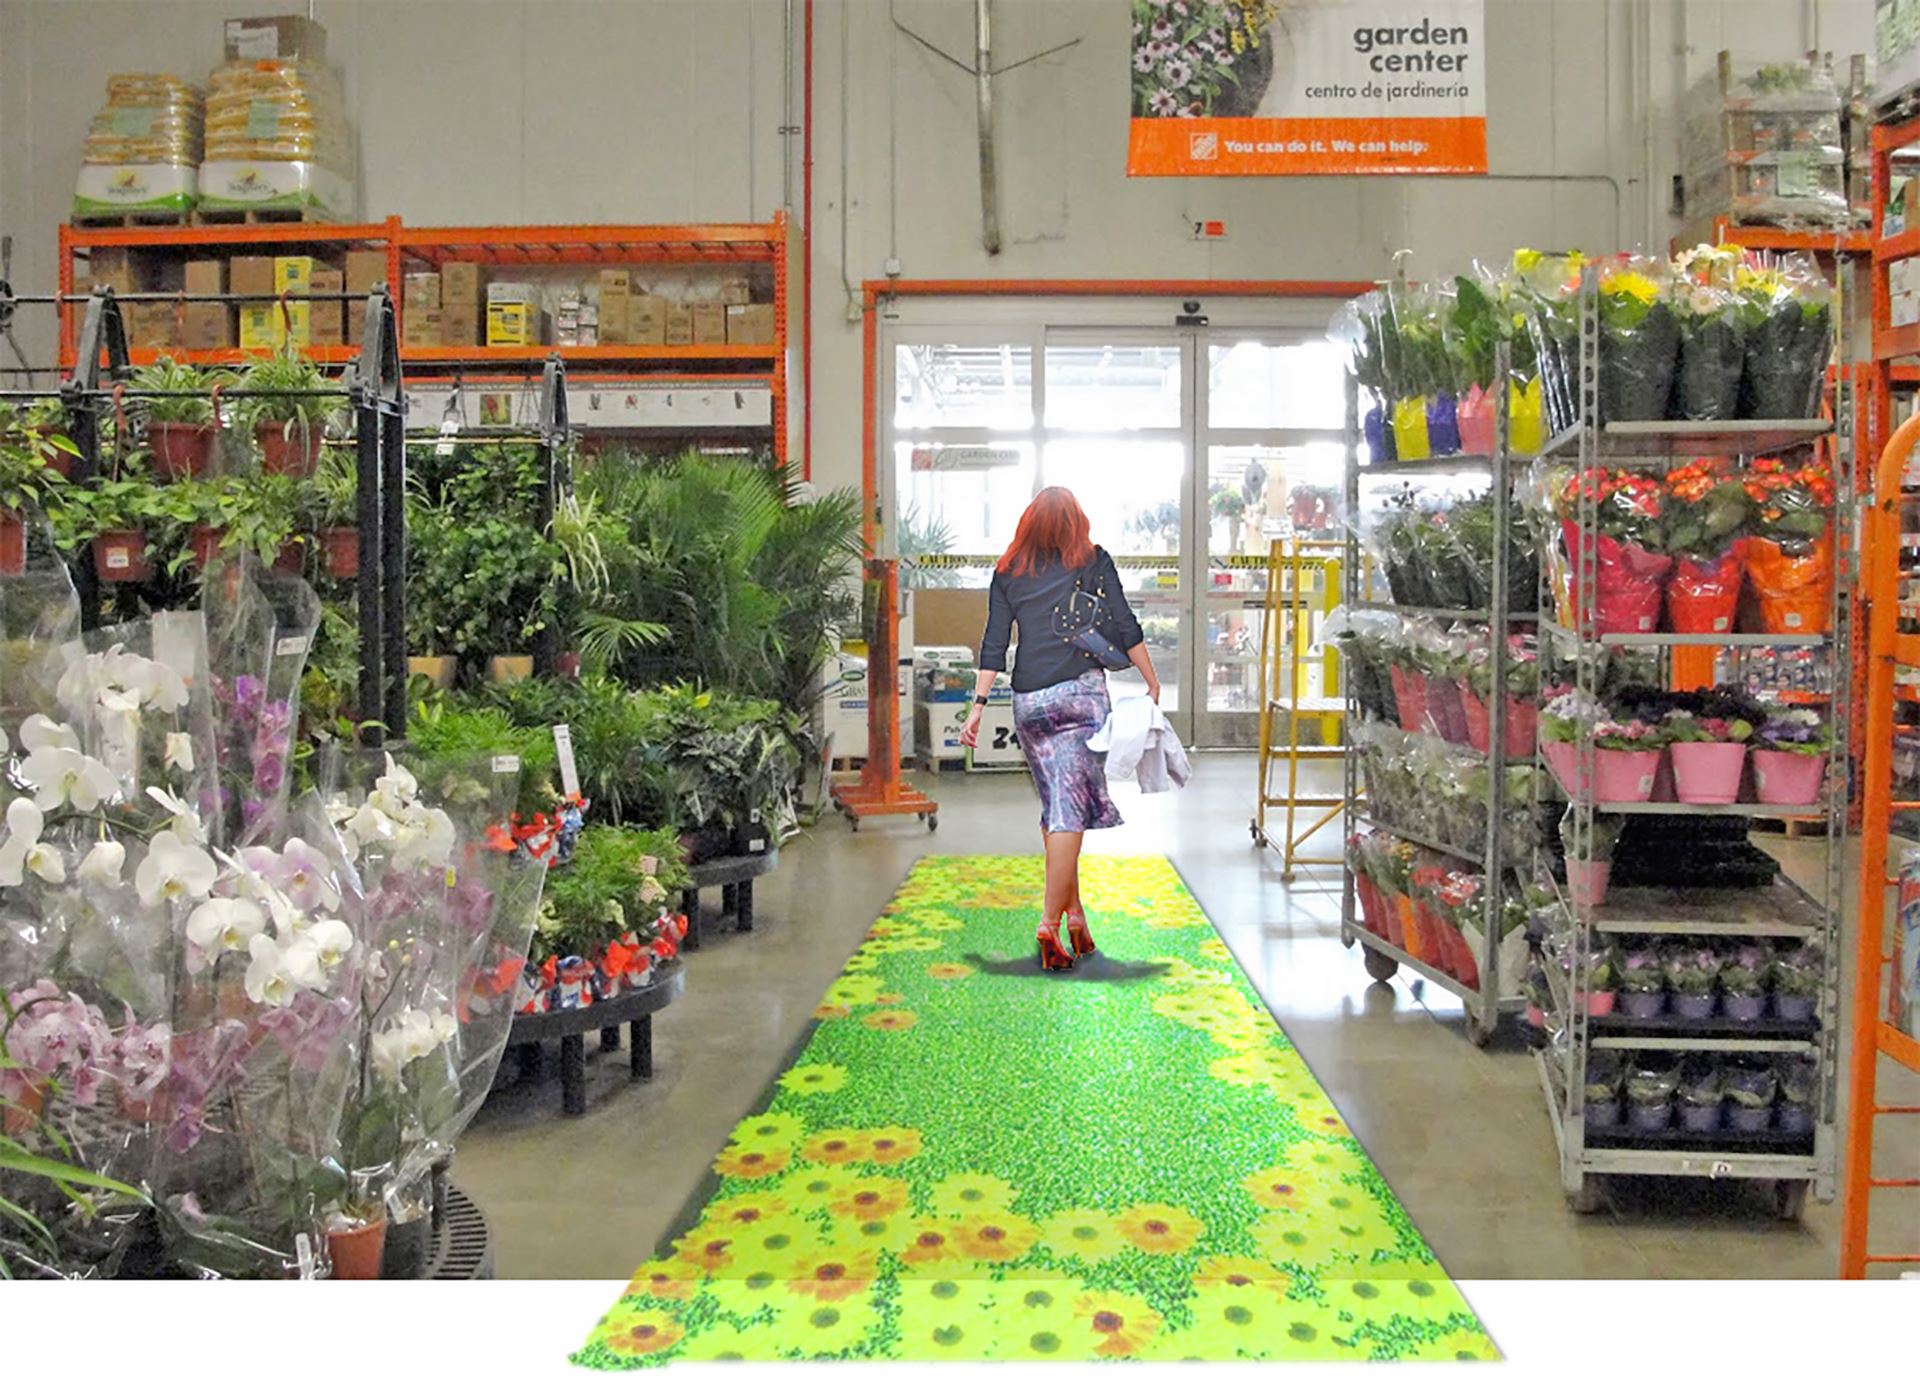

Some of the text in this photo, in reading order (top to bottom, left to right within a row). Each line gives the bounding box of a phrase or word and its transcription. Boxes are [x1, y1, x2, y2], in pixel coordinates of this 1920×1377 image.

[1353, 17, 1468, 53] garden
[1369, 50, 1468, 72] center
[1305, 80, 1469, 101] centro de jardinería
[1224, 140, 1254, 153] You
[1256, 143, 1284, 153] can
[1287, 140, 1307, 153] do
[1310, 140, 1327, 153] it.
[1331, 140, 1355, 153] We
[1359, 143, 1385, 153] can
